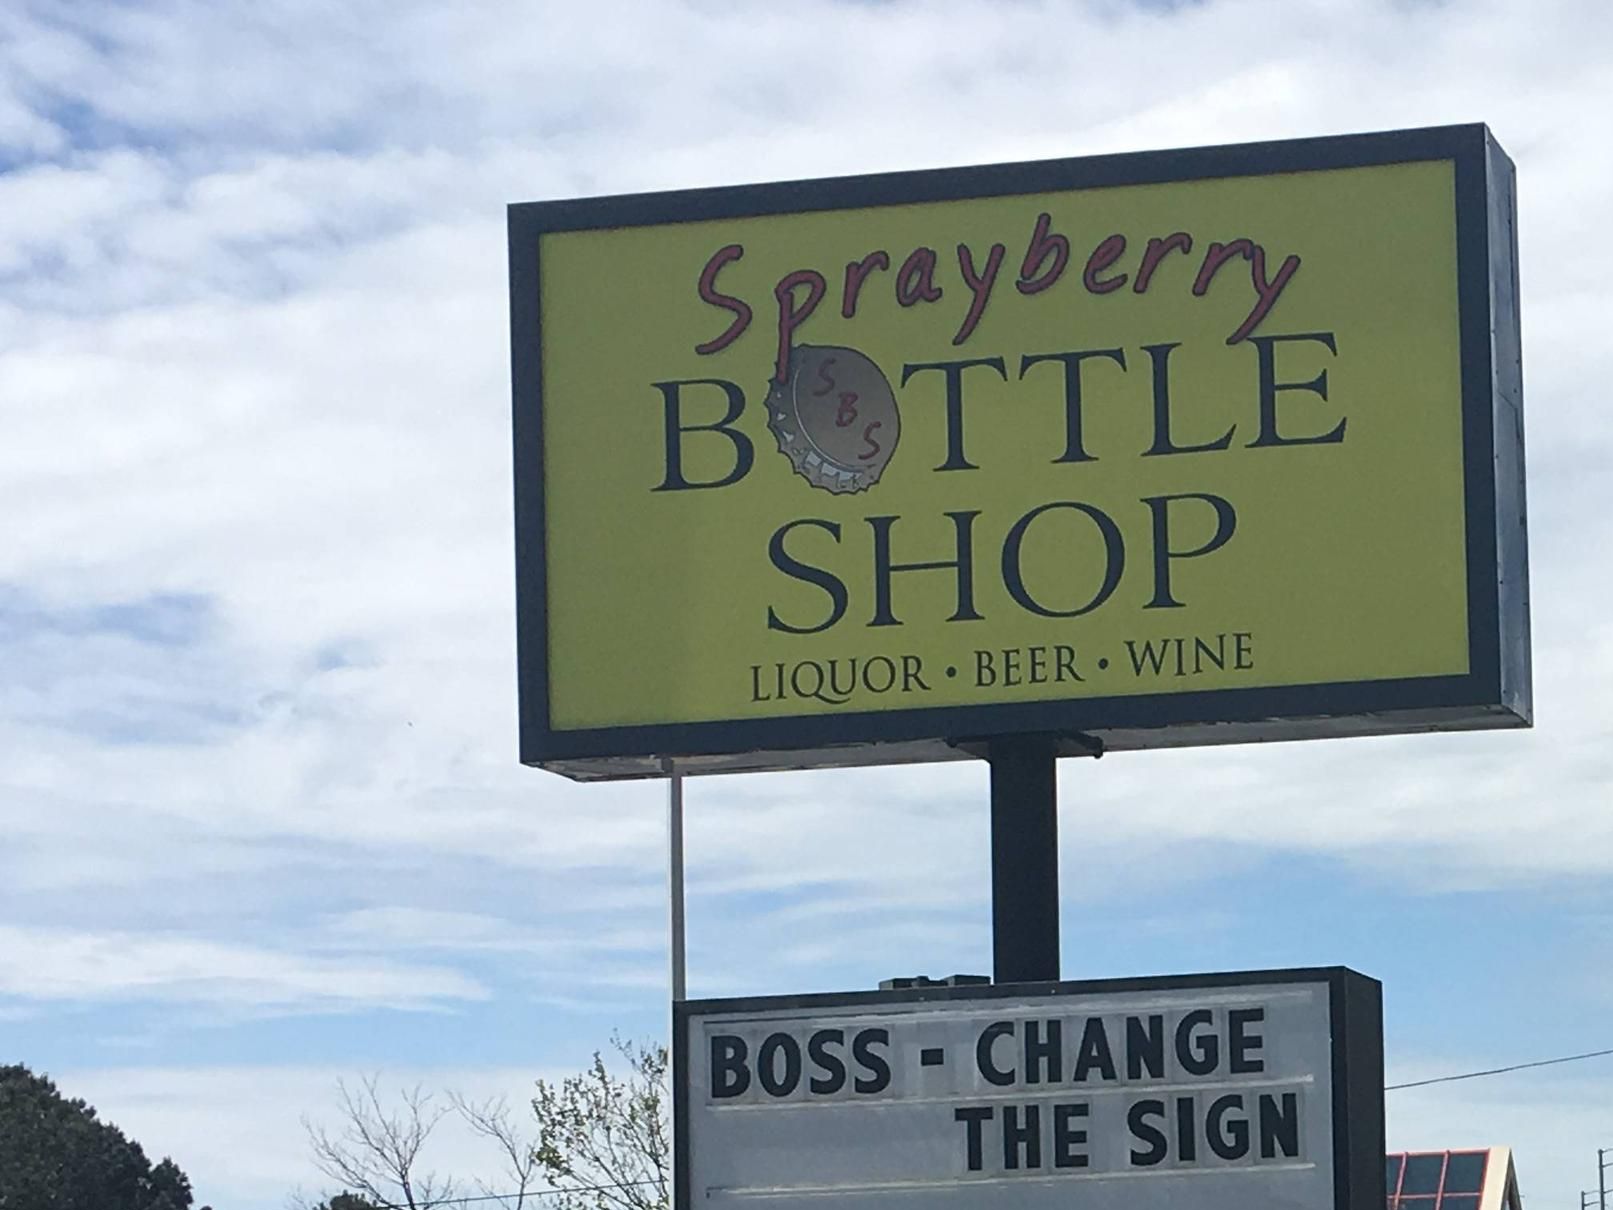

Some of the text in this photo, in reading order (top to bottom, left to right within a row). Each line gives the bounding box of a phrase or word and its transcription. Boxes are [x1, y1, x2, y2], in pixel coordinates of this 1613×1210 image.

[694, 213, 1301, 380] Sprayberry
[766, 492, 1238, 636] SHOP
[750, 633, 1255, 705] LIQUOR BEER WINE
[710, 1028, 891, 1098] BOSS
[976, 1008, 1265, 1086] CHANGE
[954, 1092, 1299, 1171] THE SIGN
